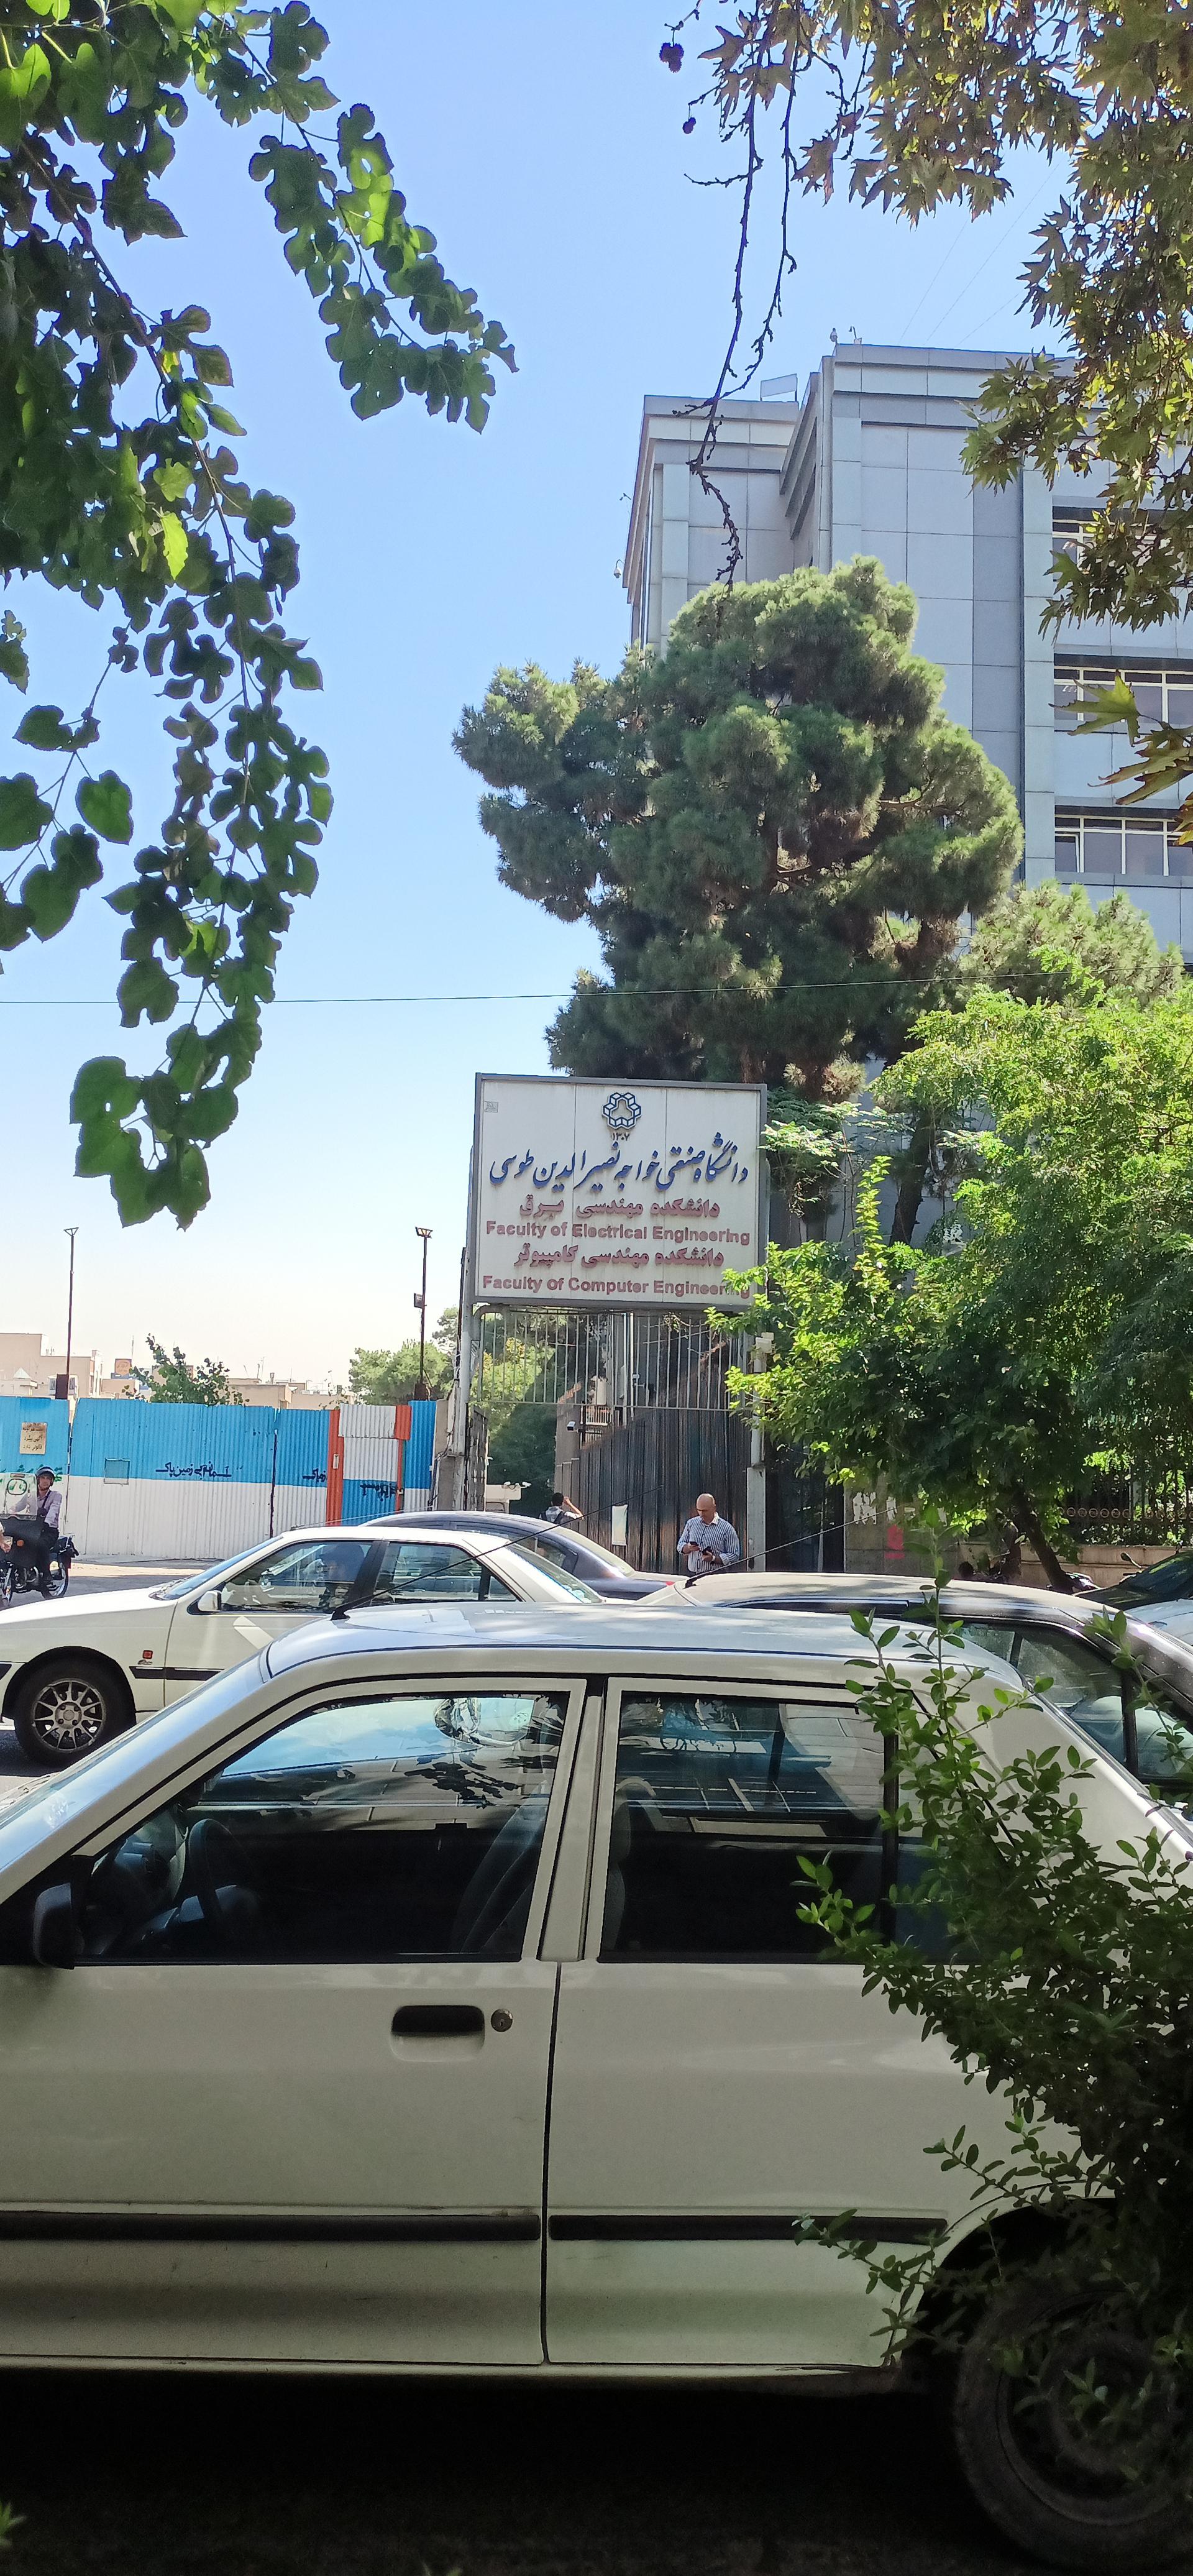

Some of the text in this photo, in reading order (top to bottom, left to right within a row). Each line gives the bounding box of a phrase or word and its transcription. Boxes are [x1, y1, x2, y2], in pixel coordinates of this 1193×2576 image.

[489, 1149, 534, 1186] طوسی
[614, 1150, 660, 1191] خواجه
[656, 1146, 706, 1191] صنعتی
[693, 1131, 748, 1184] دانشگاه
[519, 1194, 720, 1219] دانشکده مهندسی برق
[487, 1221, 750, 1245] Faculty of Electrical Engineering
[513, 1242, 724, 1268] دانشکده مهندسی کامپیوتر
[483, 1275, 751, 1299] Faculty of Computer Engineerg
[155, 1462, 175, 1477] پاک
